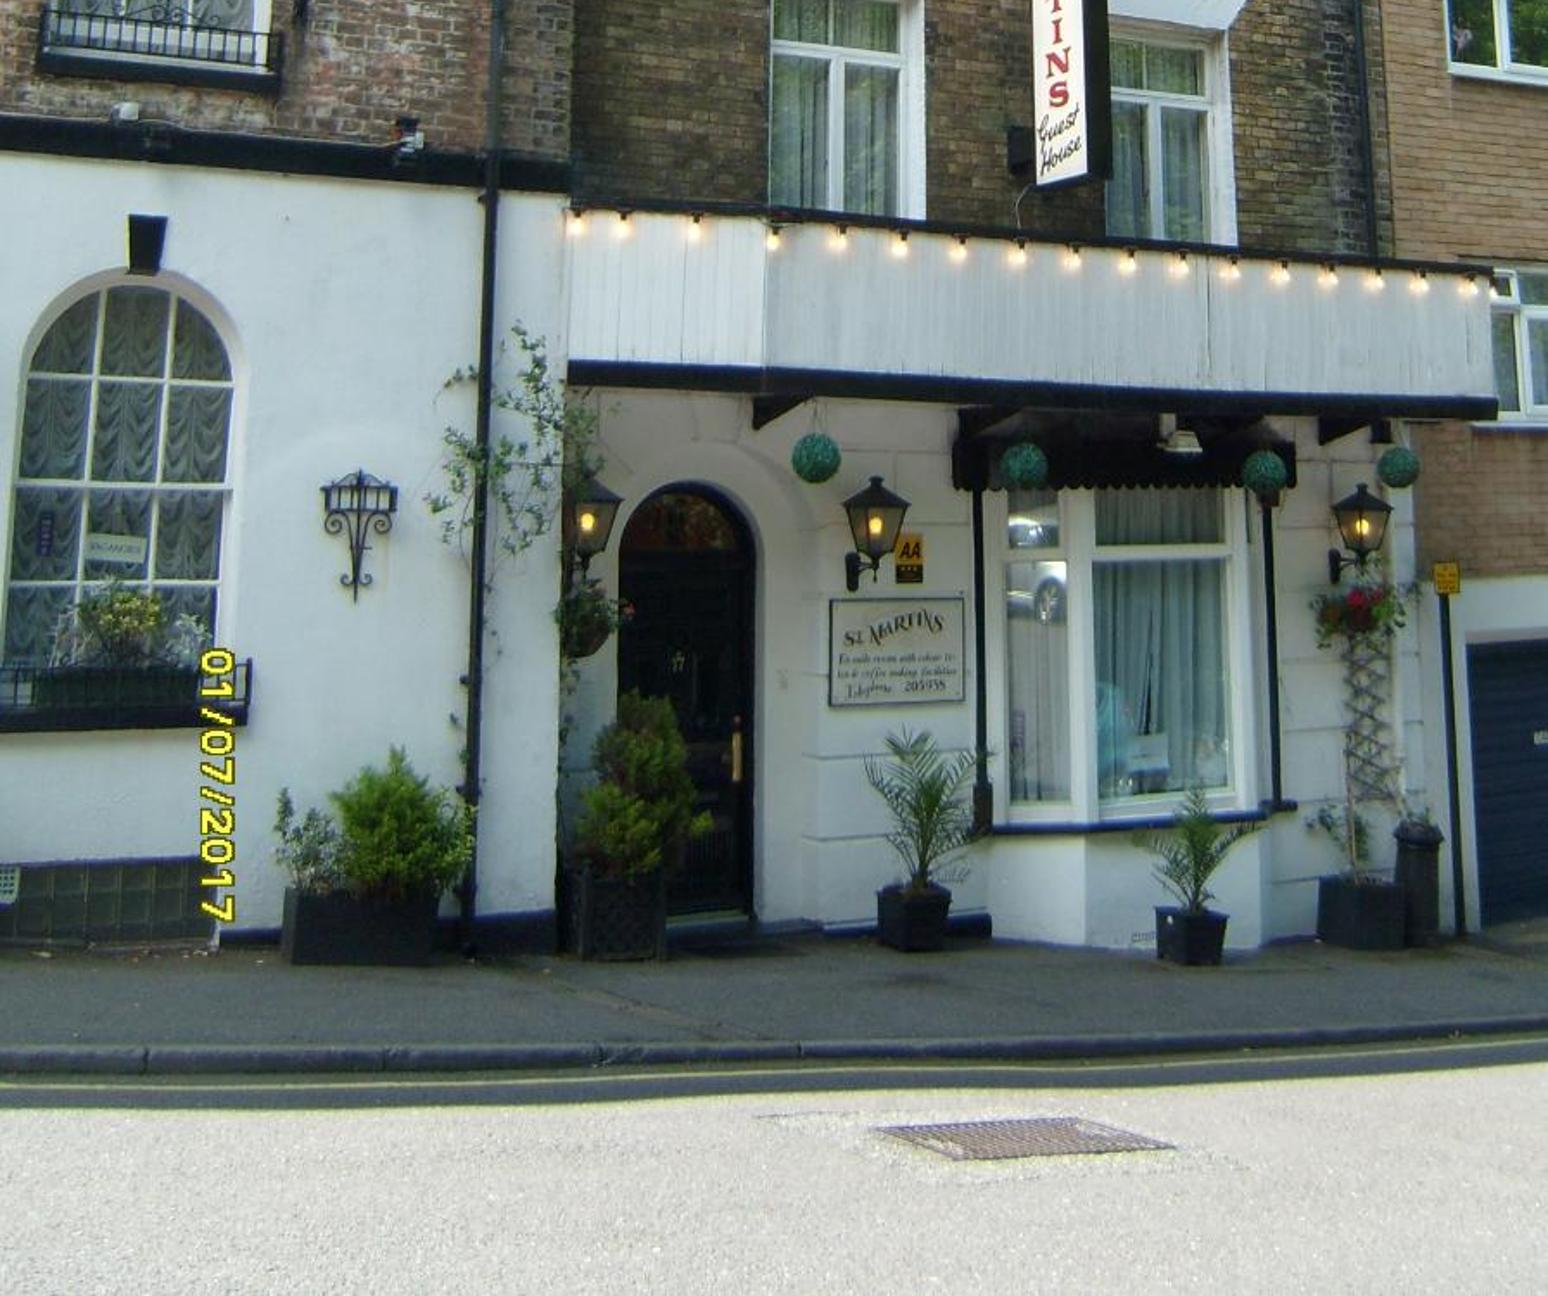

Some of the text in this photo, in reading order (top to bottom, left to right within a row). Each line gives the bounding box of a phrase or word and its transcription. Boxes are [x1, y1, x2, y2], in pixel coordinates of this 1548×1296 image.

[1037, 102, 1080, 144] Guest
[1040, 136, 1082, 177] House
[898, 542, 921, 559] AA
